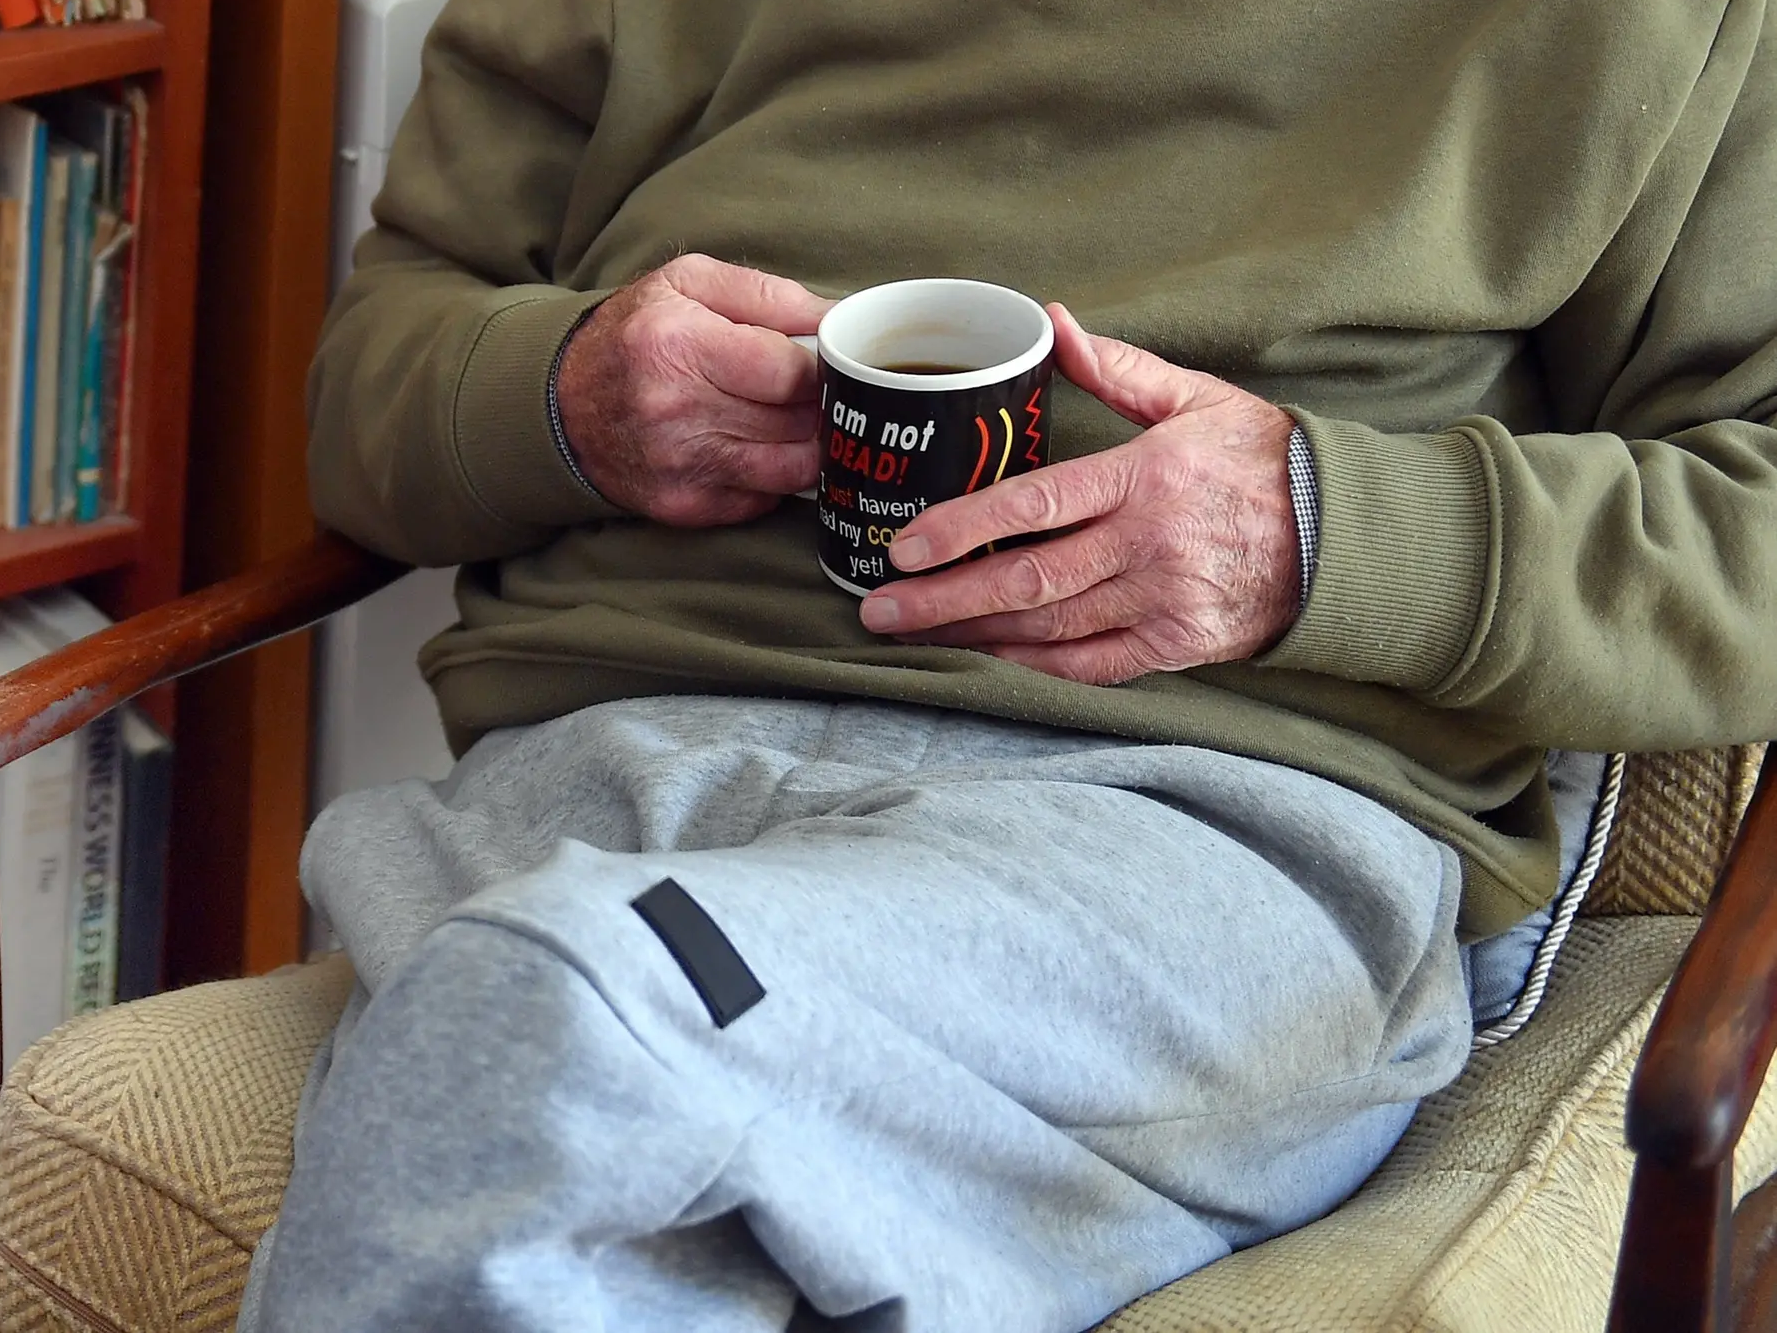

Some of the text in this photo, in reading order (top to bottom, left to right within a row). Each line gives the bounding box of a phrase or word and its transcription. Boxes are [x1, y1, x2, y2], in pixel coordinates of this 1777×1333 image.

[821, 383, 936, 452] I am not
[829, 429, 910, 486] DEAD!
[827, 484, 928, 518] just haven't
[839, 519, 862, 548] my
[849, 556, 884, 579] yet!
[77, 834, 109, 956] WORLD
